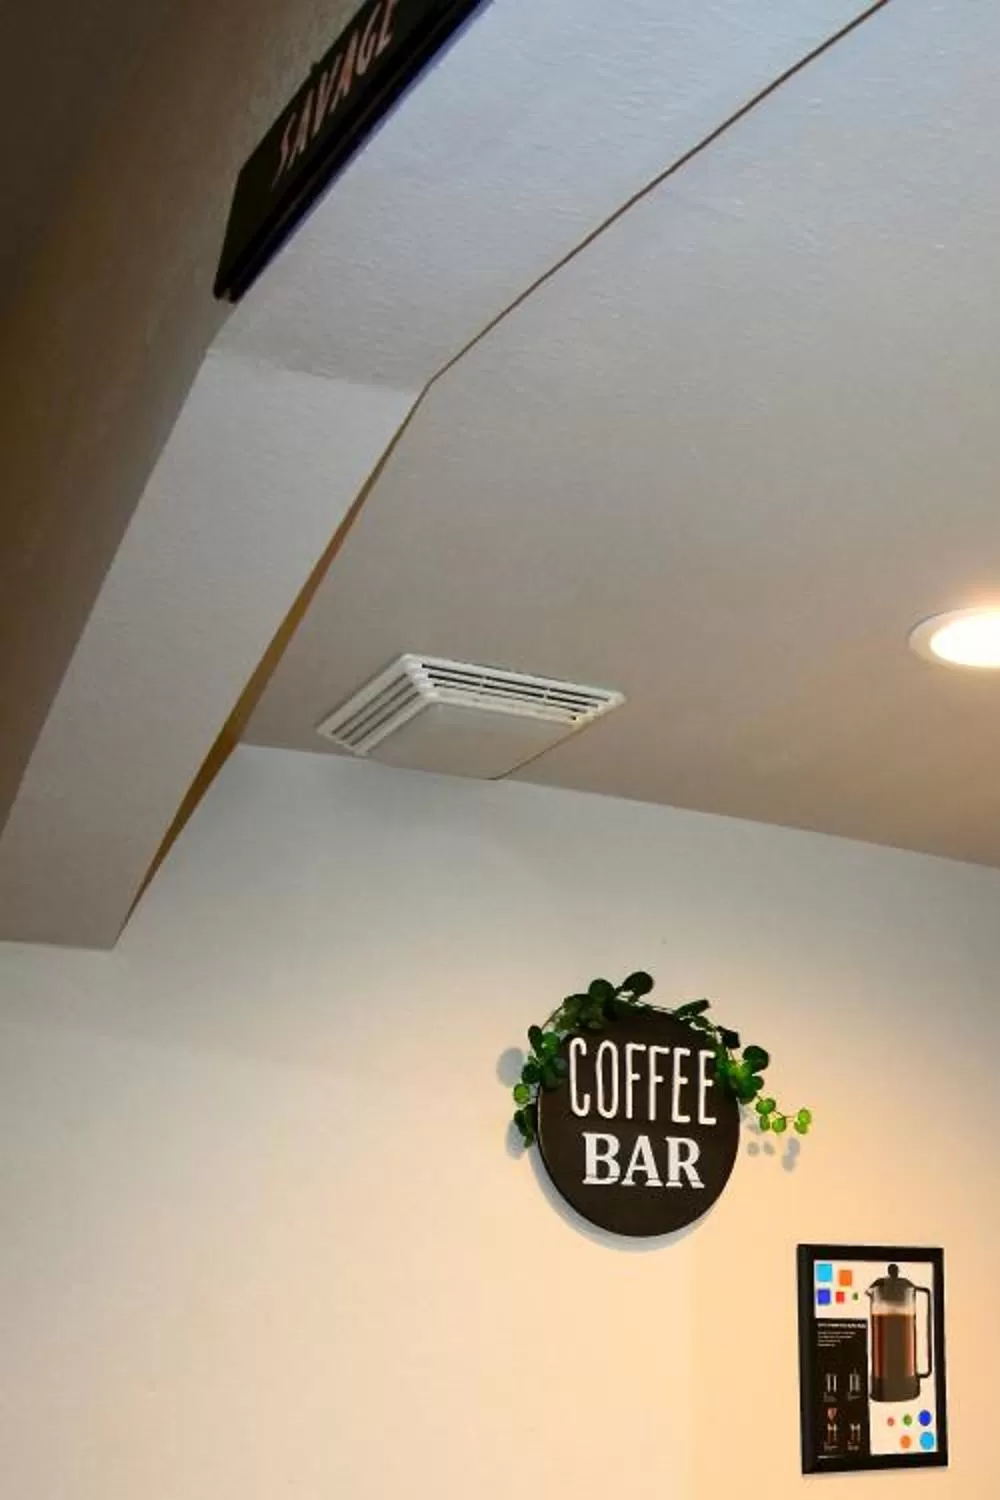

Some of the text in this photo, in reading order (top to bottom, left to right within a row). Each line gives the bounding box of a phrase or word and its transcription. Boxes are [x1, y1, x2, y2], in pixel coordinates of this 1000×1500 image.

[271, 0, 399, 191] SAVAGE
[569, 1036, 717, 1126] COFFEE
[581, 1131, 706, 1189] BAR
